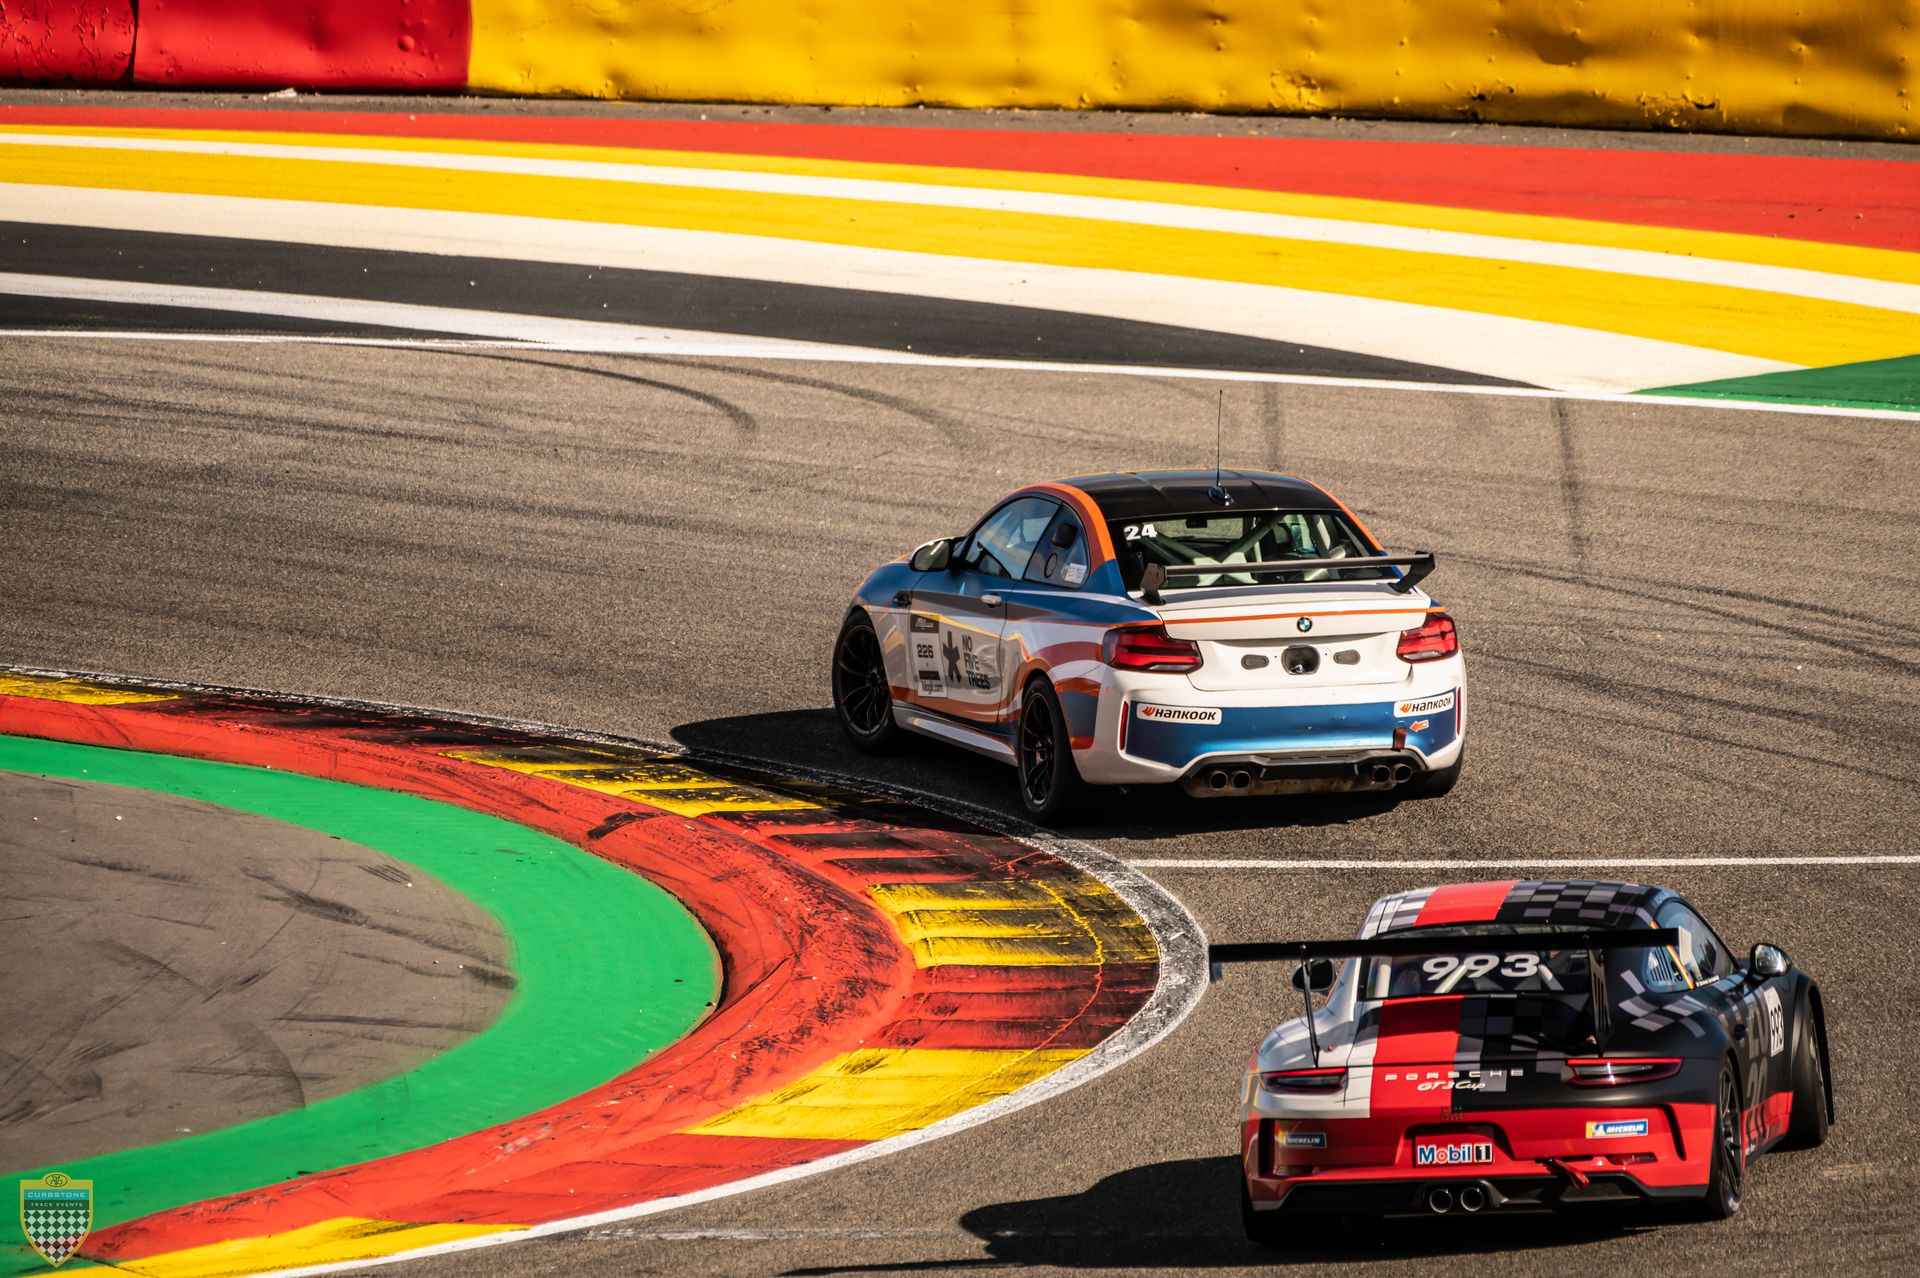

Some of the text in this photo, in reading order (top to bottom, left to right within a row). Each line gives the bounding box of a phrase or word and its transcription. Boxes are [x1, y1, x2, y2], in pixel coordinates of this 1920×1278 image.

[1124, 524, 1158, 541] 24
[917, 644, 933, 658] 226
[962, 634, 973, 653] NO
[963, 653, 979, 671] FIVE
[966, 670, 991, 690] TREES
[1422, 954, 1540, 981] 993
[1770, 1004, 1784, 1051] 993
[1384, 1068, 1524, 1081] PORSCHE
[1455, 1080, 1486, 1091] Cup
[1606, 1124, 1645, 1134] MICHELIN
[1418, 1145, 1473, 1165] Mobil
